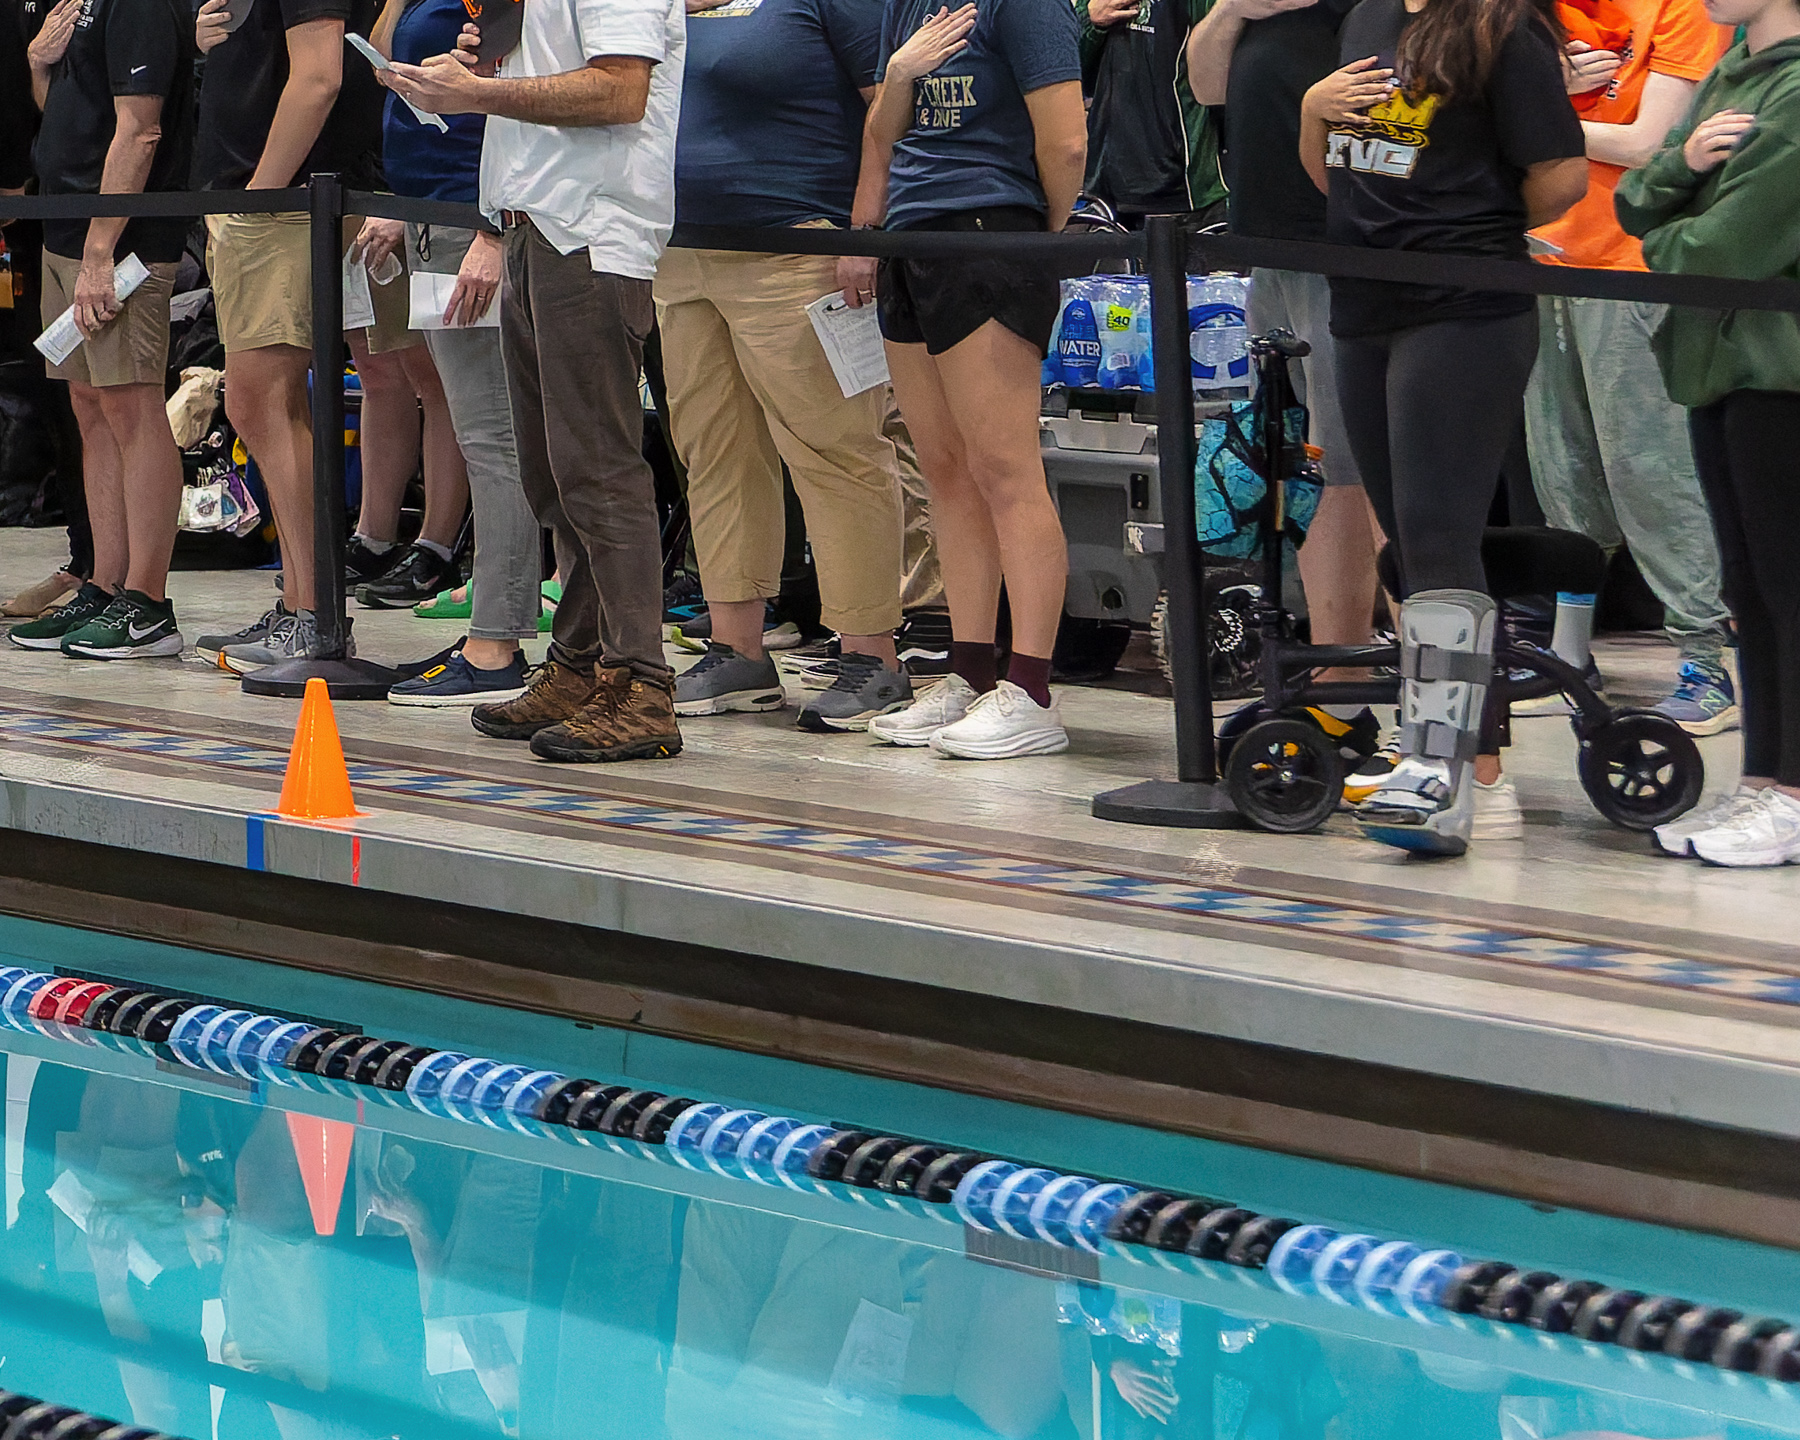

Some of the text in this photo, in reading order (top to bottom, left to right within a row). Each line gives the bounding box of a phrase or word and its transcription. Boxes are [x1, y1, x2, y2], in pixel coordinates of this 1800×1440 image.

[923, 75, 978, 109] CREEK
[932, 109, 962, 128] DIVE
[1113, 315, 1131, 327] 40
[1059, 338, 1102, 358] WATER
